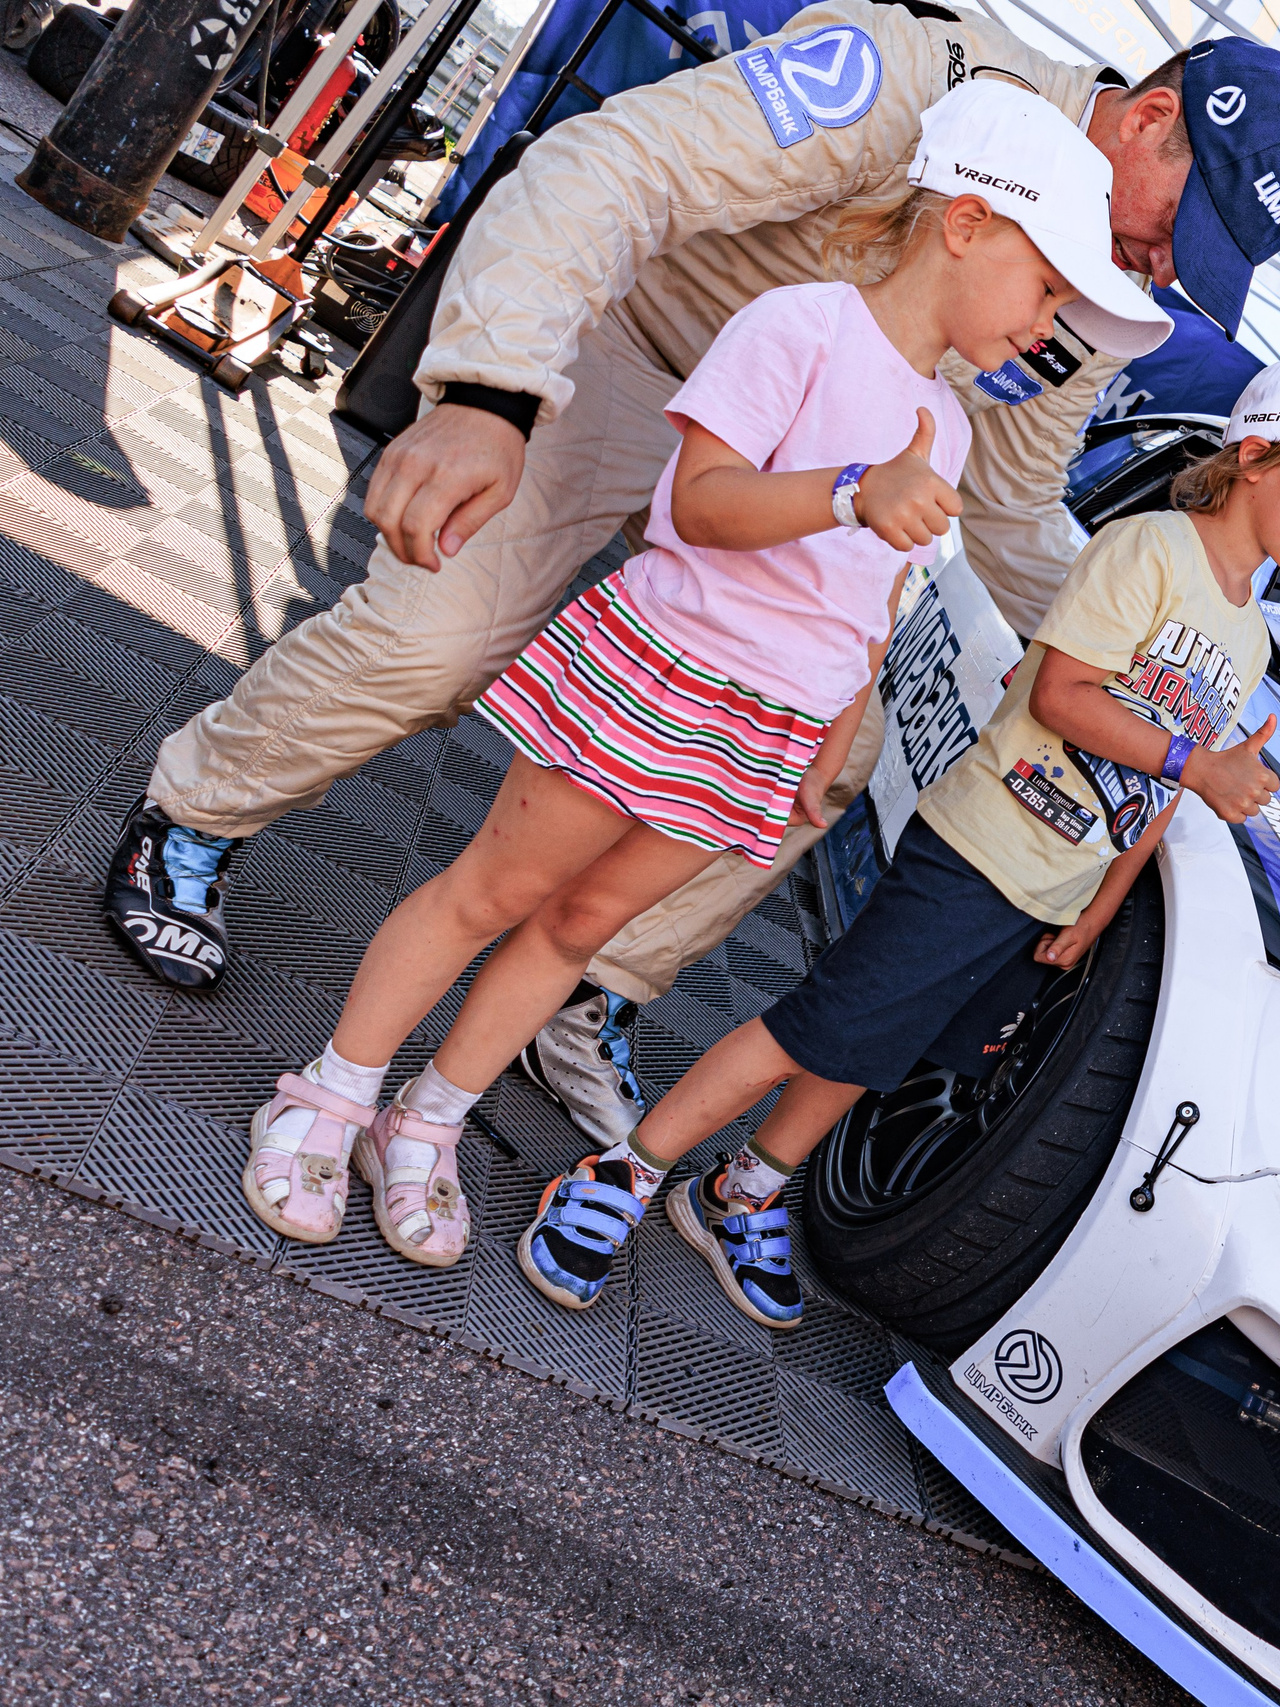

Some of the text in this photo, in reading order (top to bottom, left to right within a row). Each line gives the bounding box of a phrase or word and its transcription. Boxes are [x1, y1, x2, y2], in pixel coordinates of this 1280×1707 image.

[746, 53, 799, 127] ЦМРБанк
[1009, 777, 1048, 811] -0.265
[1031, 774, 1076, 811] Little Legend
[1125, 775, 1142, 792] 33
[1060, 811, 1070, 822] lap
[123, 917, 223, 965] OMP
[963, 1362, 1039, 1442] ЦМРБанк
